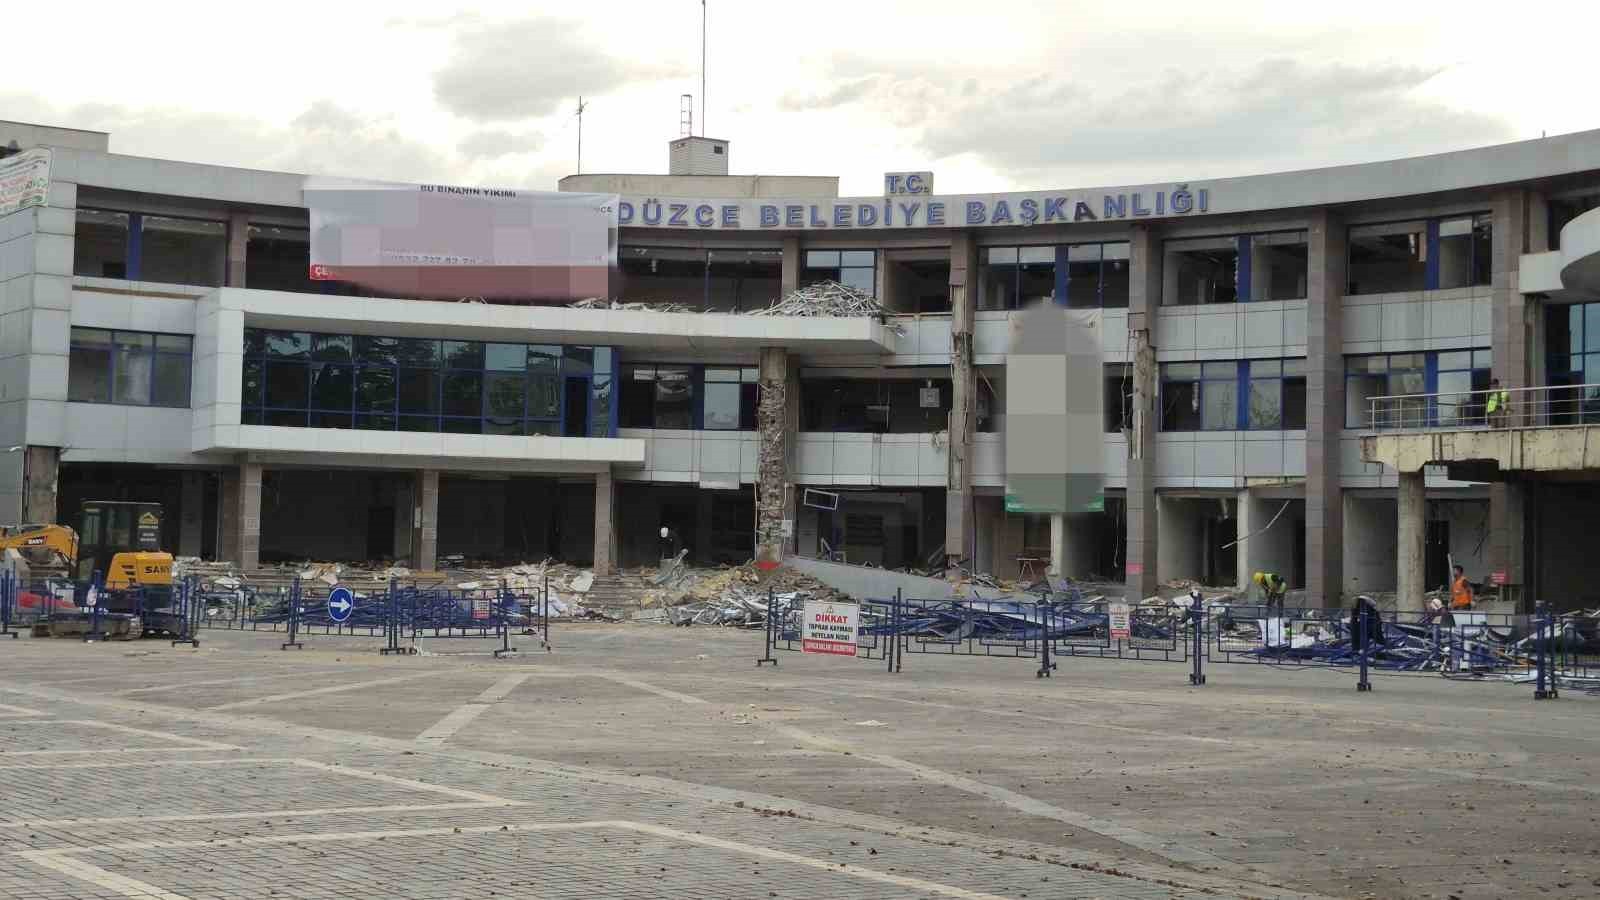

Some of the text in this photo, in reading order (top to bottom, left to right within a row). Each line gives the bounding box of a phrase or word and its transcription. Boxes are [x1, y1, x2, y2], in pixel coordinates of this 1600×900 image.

[885, 175, 929, 193] T.C.
[618, 184, 1209, 227] DÜZCE BELEDİYE BAŞKANLIĞI
